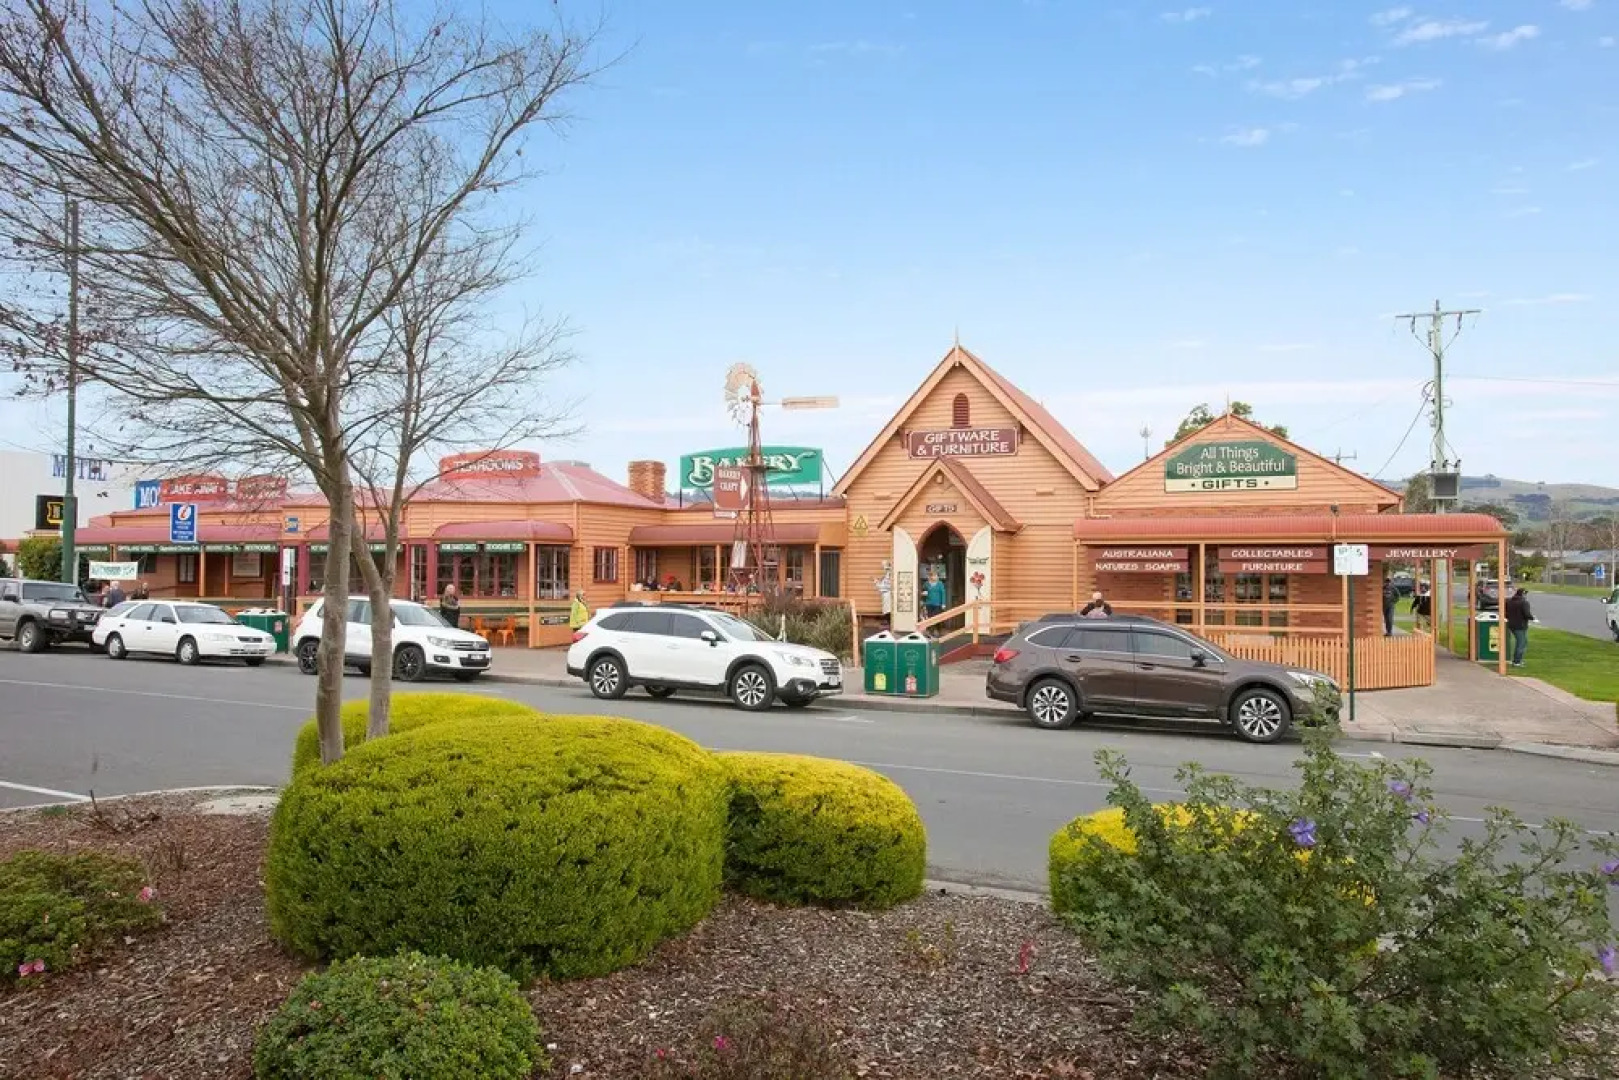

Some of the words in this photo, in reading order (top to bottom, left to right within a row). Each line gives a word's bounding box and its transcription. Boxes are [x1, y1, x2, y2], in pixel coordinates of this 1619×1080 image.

[924, 430, 1000, 443] GIFTWARE
[917, 444, 927, 456] &
[931, 441, 1010, 456] FURNITURE
[1200, 446, 1217, 459] All
[1219, 446, 1259, 462] Things
[51, 454, 107, 481] MTEL
[1176, 461, 1213, 478] Bright
[1215, 461, 1227, 474] &
[1229, 458, 1285, 474] Beautiful
[1202, 479, 1258, 490] GIFTS
[1102, 549, 1174, 558] AUSTRALIANA
[1231, 549, 1314, 558] COLLECTABLES
[1385, 548, 1458, 558] JEWELLERY
[1095, 562, 1139, 571] NATURES
[1144, 562, 1181, 571] SOAPS
[1242, 562, 1303, 571] FURNITURE
